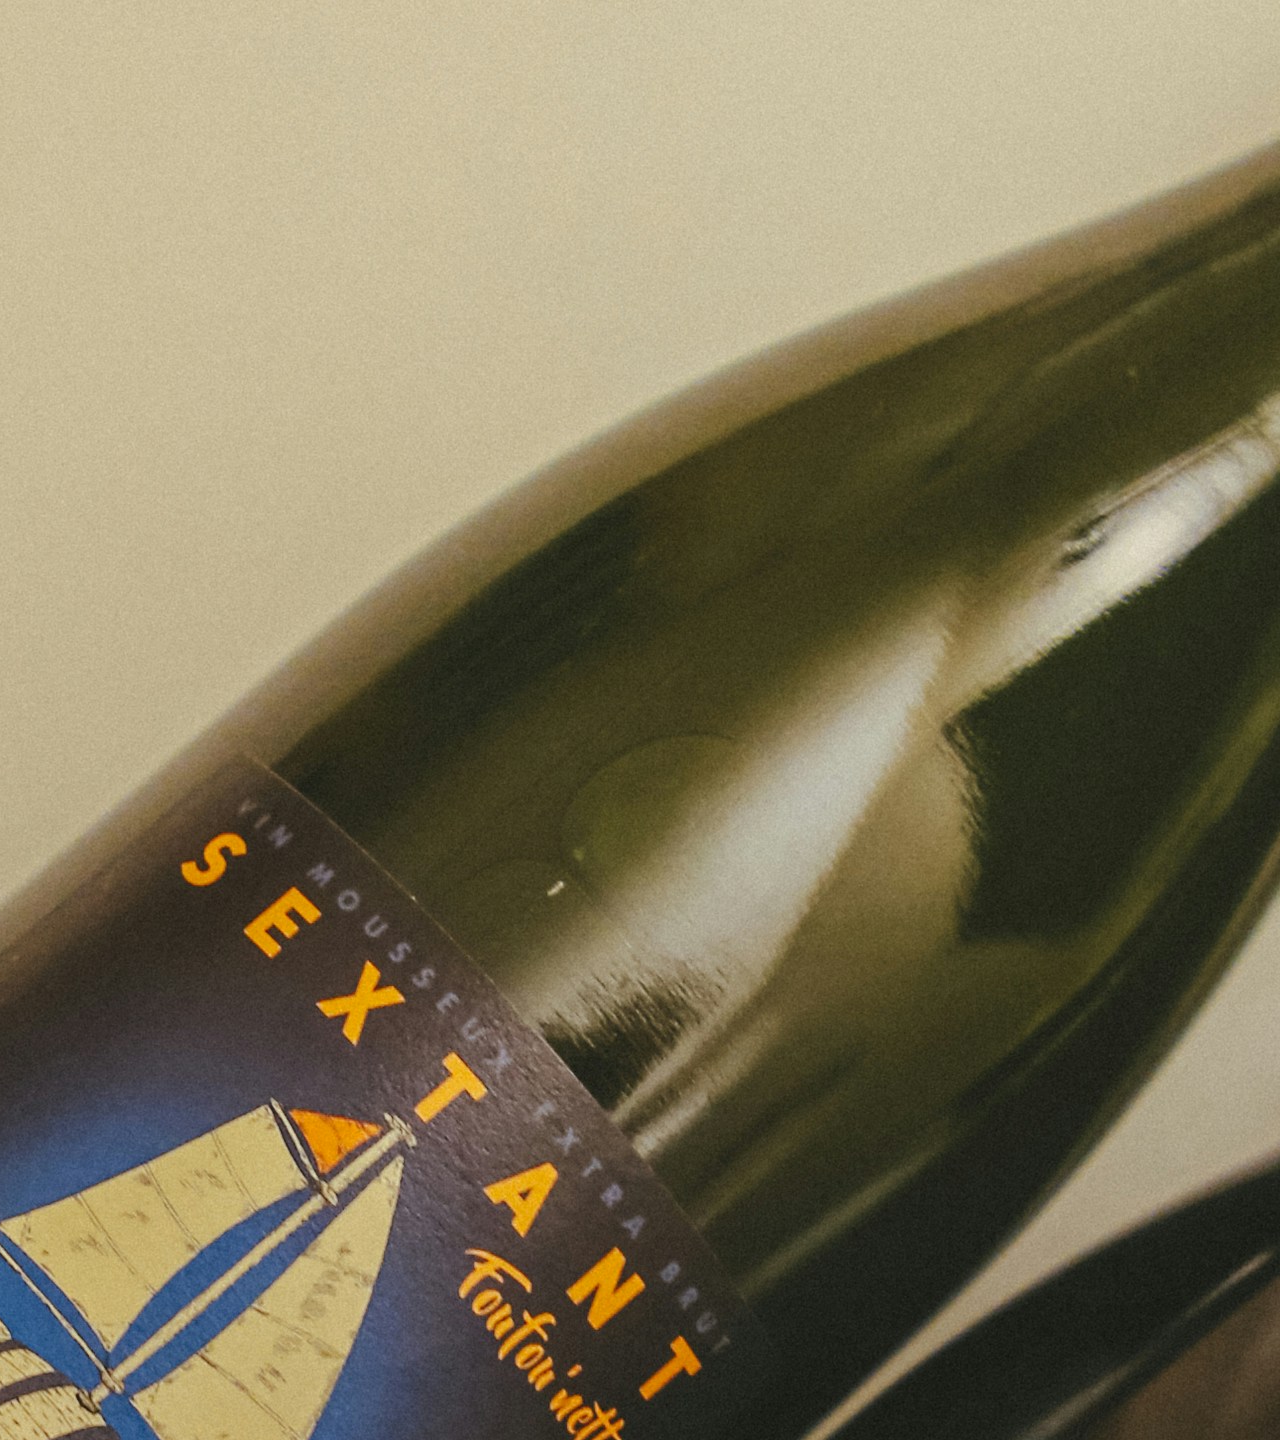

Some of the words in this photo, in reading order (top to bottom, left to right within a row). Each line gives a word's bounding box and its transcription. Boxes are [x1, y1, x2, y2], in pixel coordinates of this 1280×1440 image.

[180, 833, 702, 1401] SEXTANT
[234, 796, 296, 850] VIN
[307, 862, 515, 1076] MOUSSEUX
[530, 1100, 645, 1241] EXTRA
